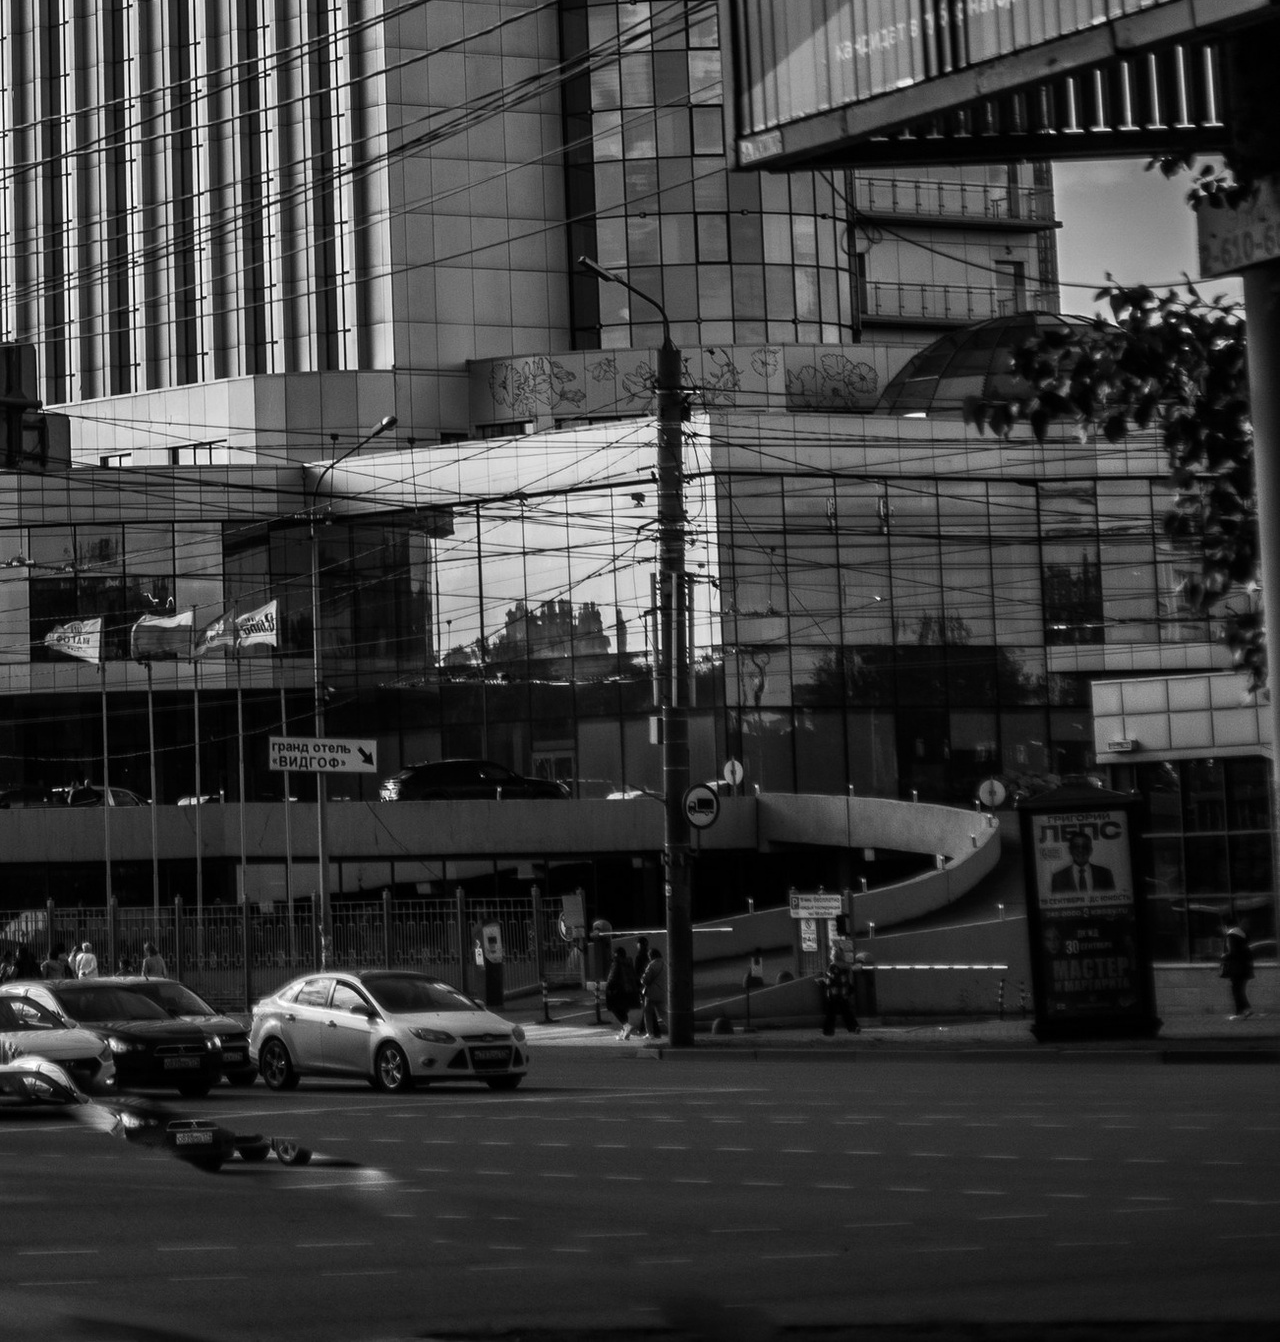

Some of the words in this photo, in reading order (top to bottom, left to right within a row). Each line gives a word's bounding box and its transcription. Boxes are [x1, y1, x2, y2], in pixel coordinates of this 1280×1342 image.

[272, 742, 309, 754] гранд
[313, 743, 351, 754] отель
[272, 756, 346, 770] «ВИДГОФ»
[1039, 821, 1122, 844] ЛЕПС
[1065, 940, 1079, 954] 30
[1052, 956, 1129, 980] МАСТЕР
